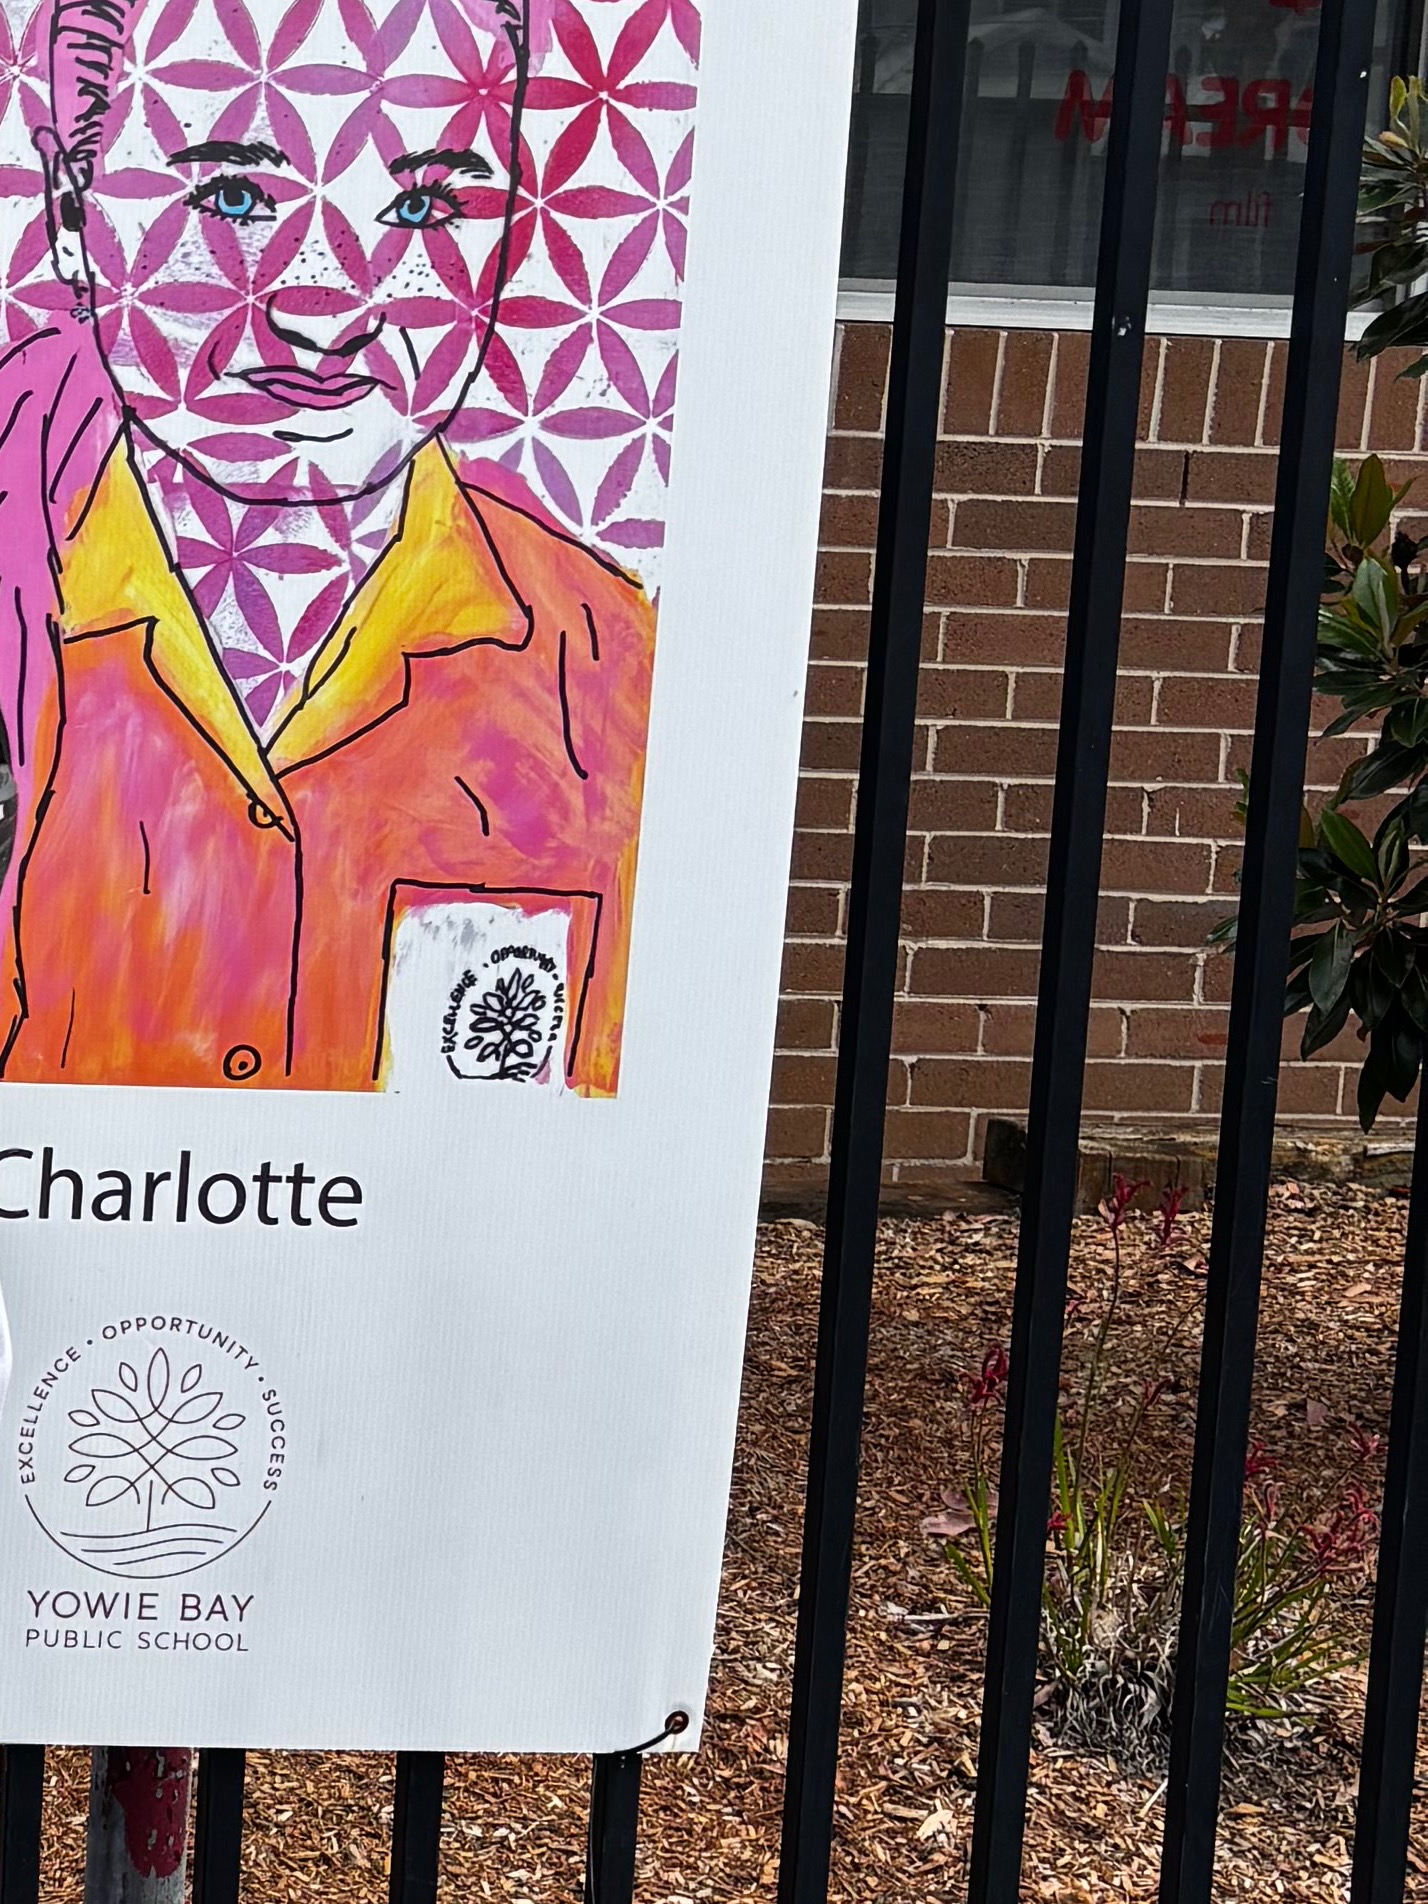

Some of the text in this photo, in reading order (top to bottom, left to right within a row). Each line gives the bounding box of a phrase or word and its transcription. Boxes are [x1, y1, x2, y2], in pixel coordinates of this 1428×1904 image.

[102, 1316, 259, 1370] OPPORTUNITY
[18, 1346, 81, 1484] EXCELLENCE
[262, 1389, 285, 1491] SUCCESS
[27, 1590, 255, 1622] YOWIE BAY
[26, 1629, 249, 1652] PUBLIC SCHOOL
